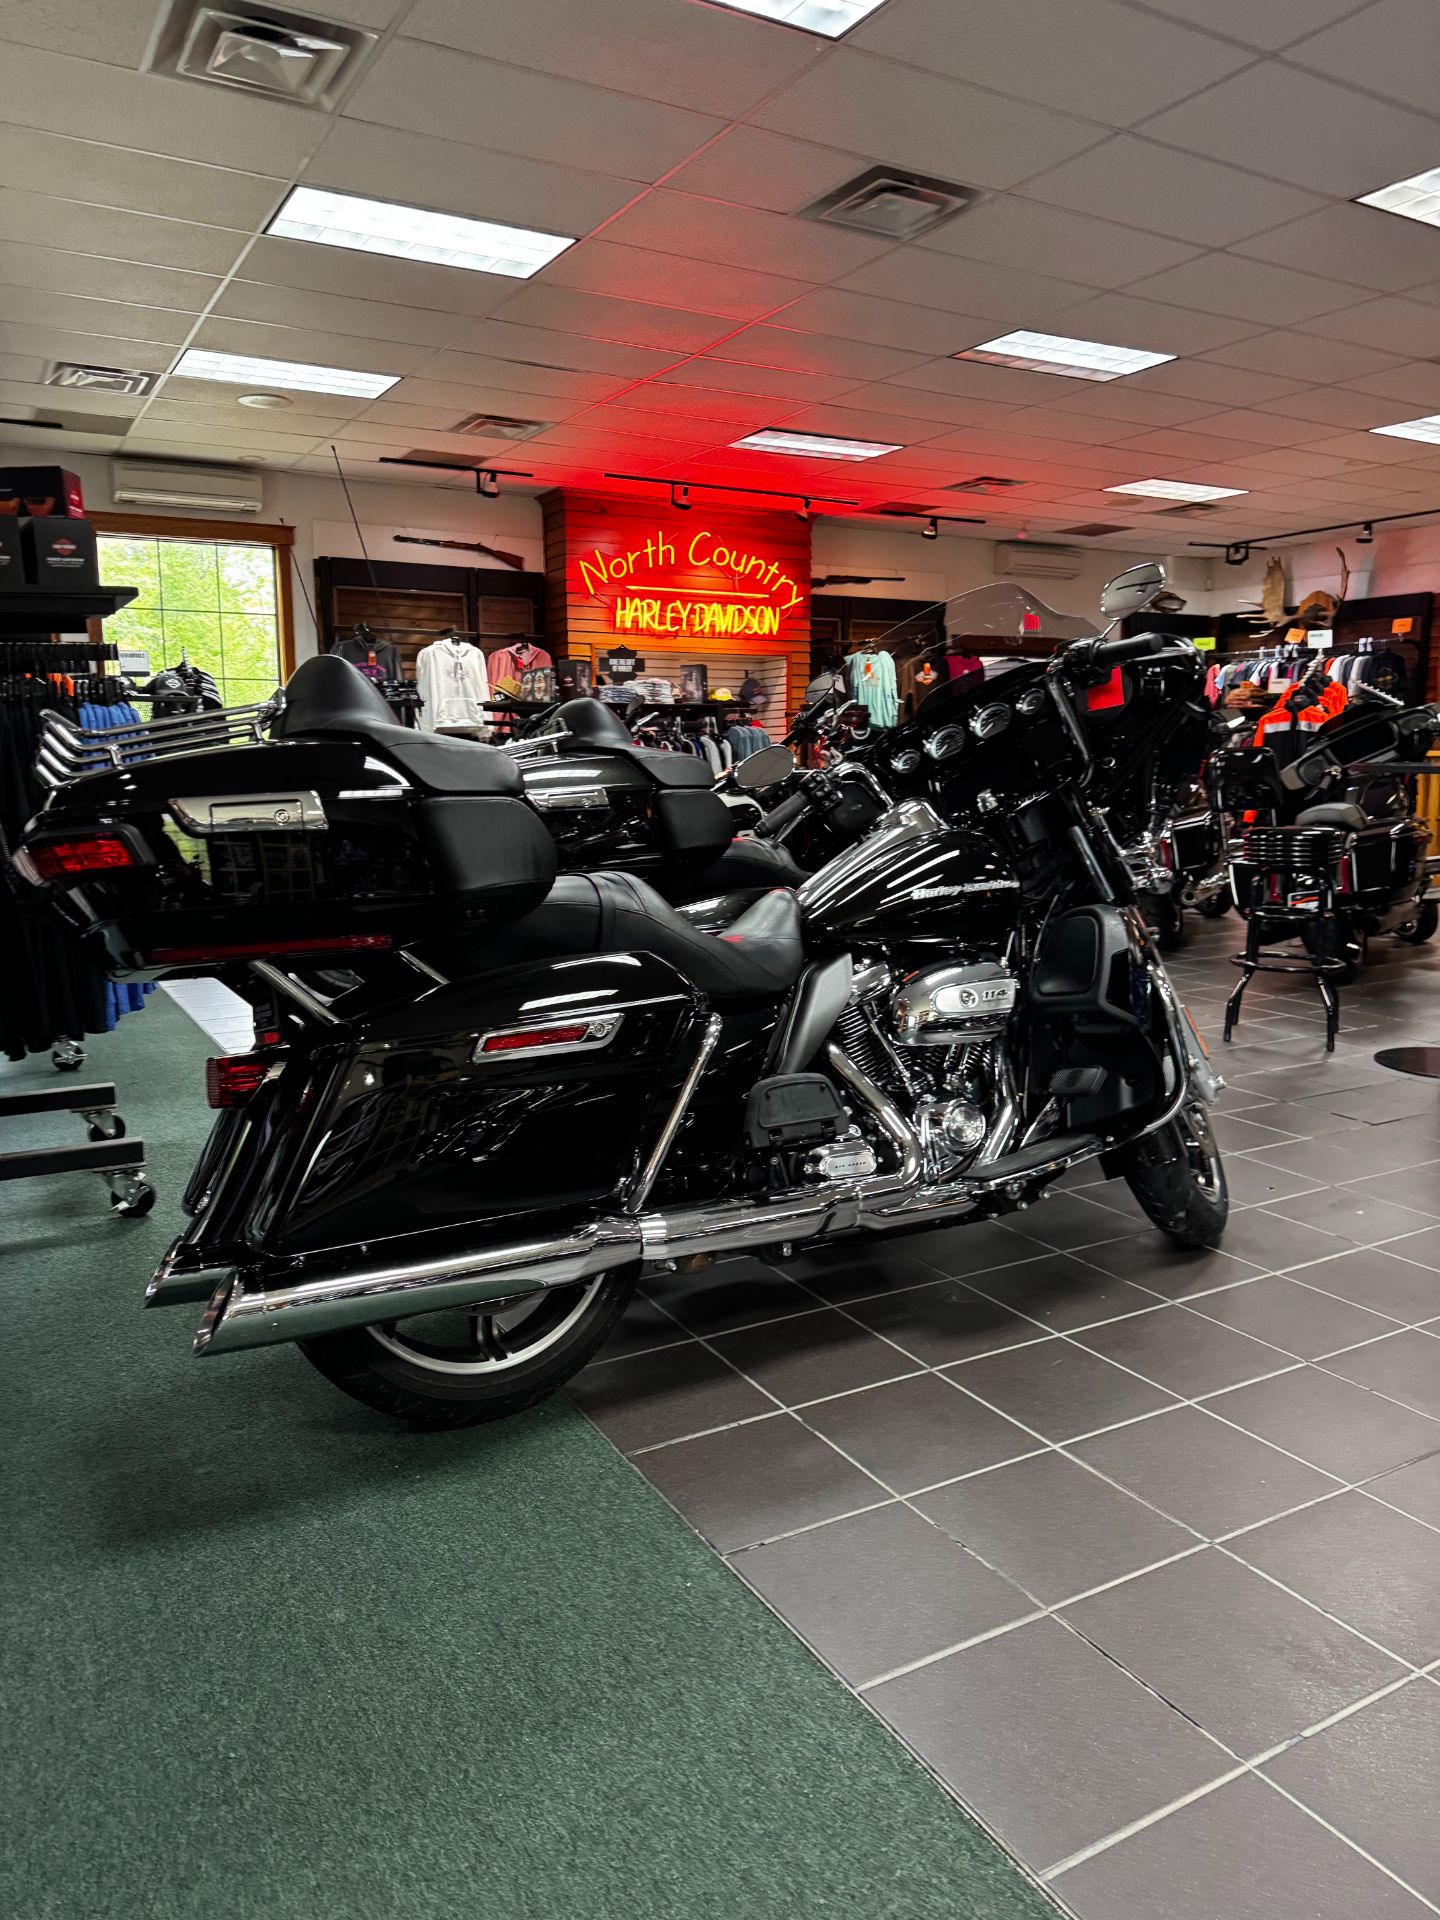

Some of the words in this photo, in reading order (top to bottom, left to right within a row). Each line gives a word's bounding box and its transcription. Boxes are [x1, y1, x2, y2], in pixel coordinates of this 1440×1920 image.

[579, 530, 675, 595] North
[688, 531, 804, 609] Country
[615, 597, 781, 635] HARLEY-DAVIDSON
[982, 988, 1008, 999] 114
